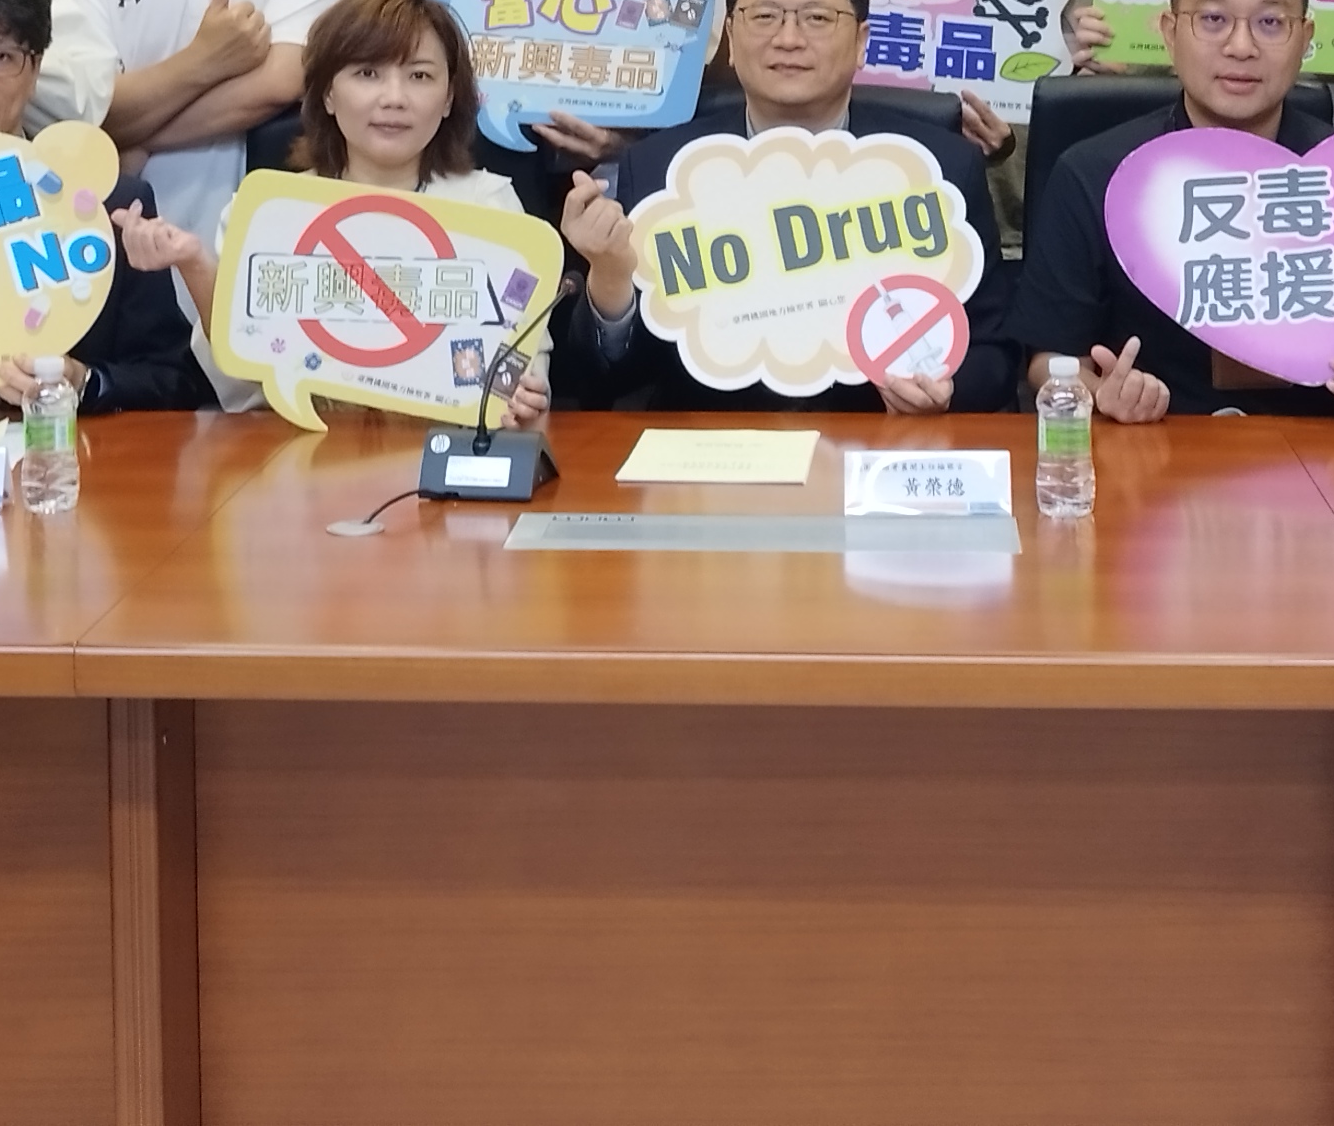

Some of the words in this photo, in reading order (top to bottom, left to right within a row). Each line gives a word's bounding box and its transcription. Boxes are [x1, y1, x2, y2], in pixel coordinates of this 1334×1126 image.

[472, 36, 658, 90] 新興毒品
[867, 12, 996, 81] 毒品
[1179, 168, 1332, 243] 反毒
[10, 232, 111, 292] No
[655, 226, 750, 297] No
[774, 191, 949, 272] Drug
[256, 259, 478, 319] 新興毒品
[902, 476, 966, 497] 黃榮德
